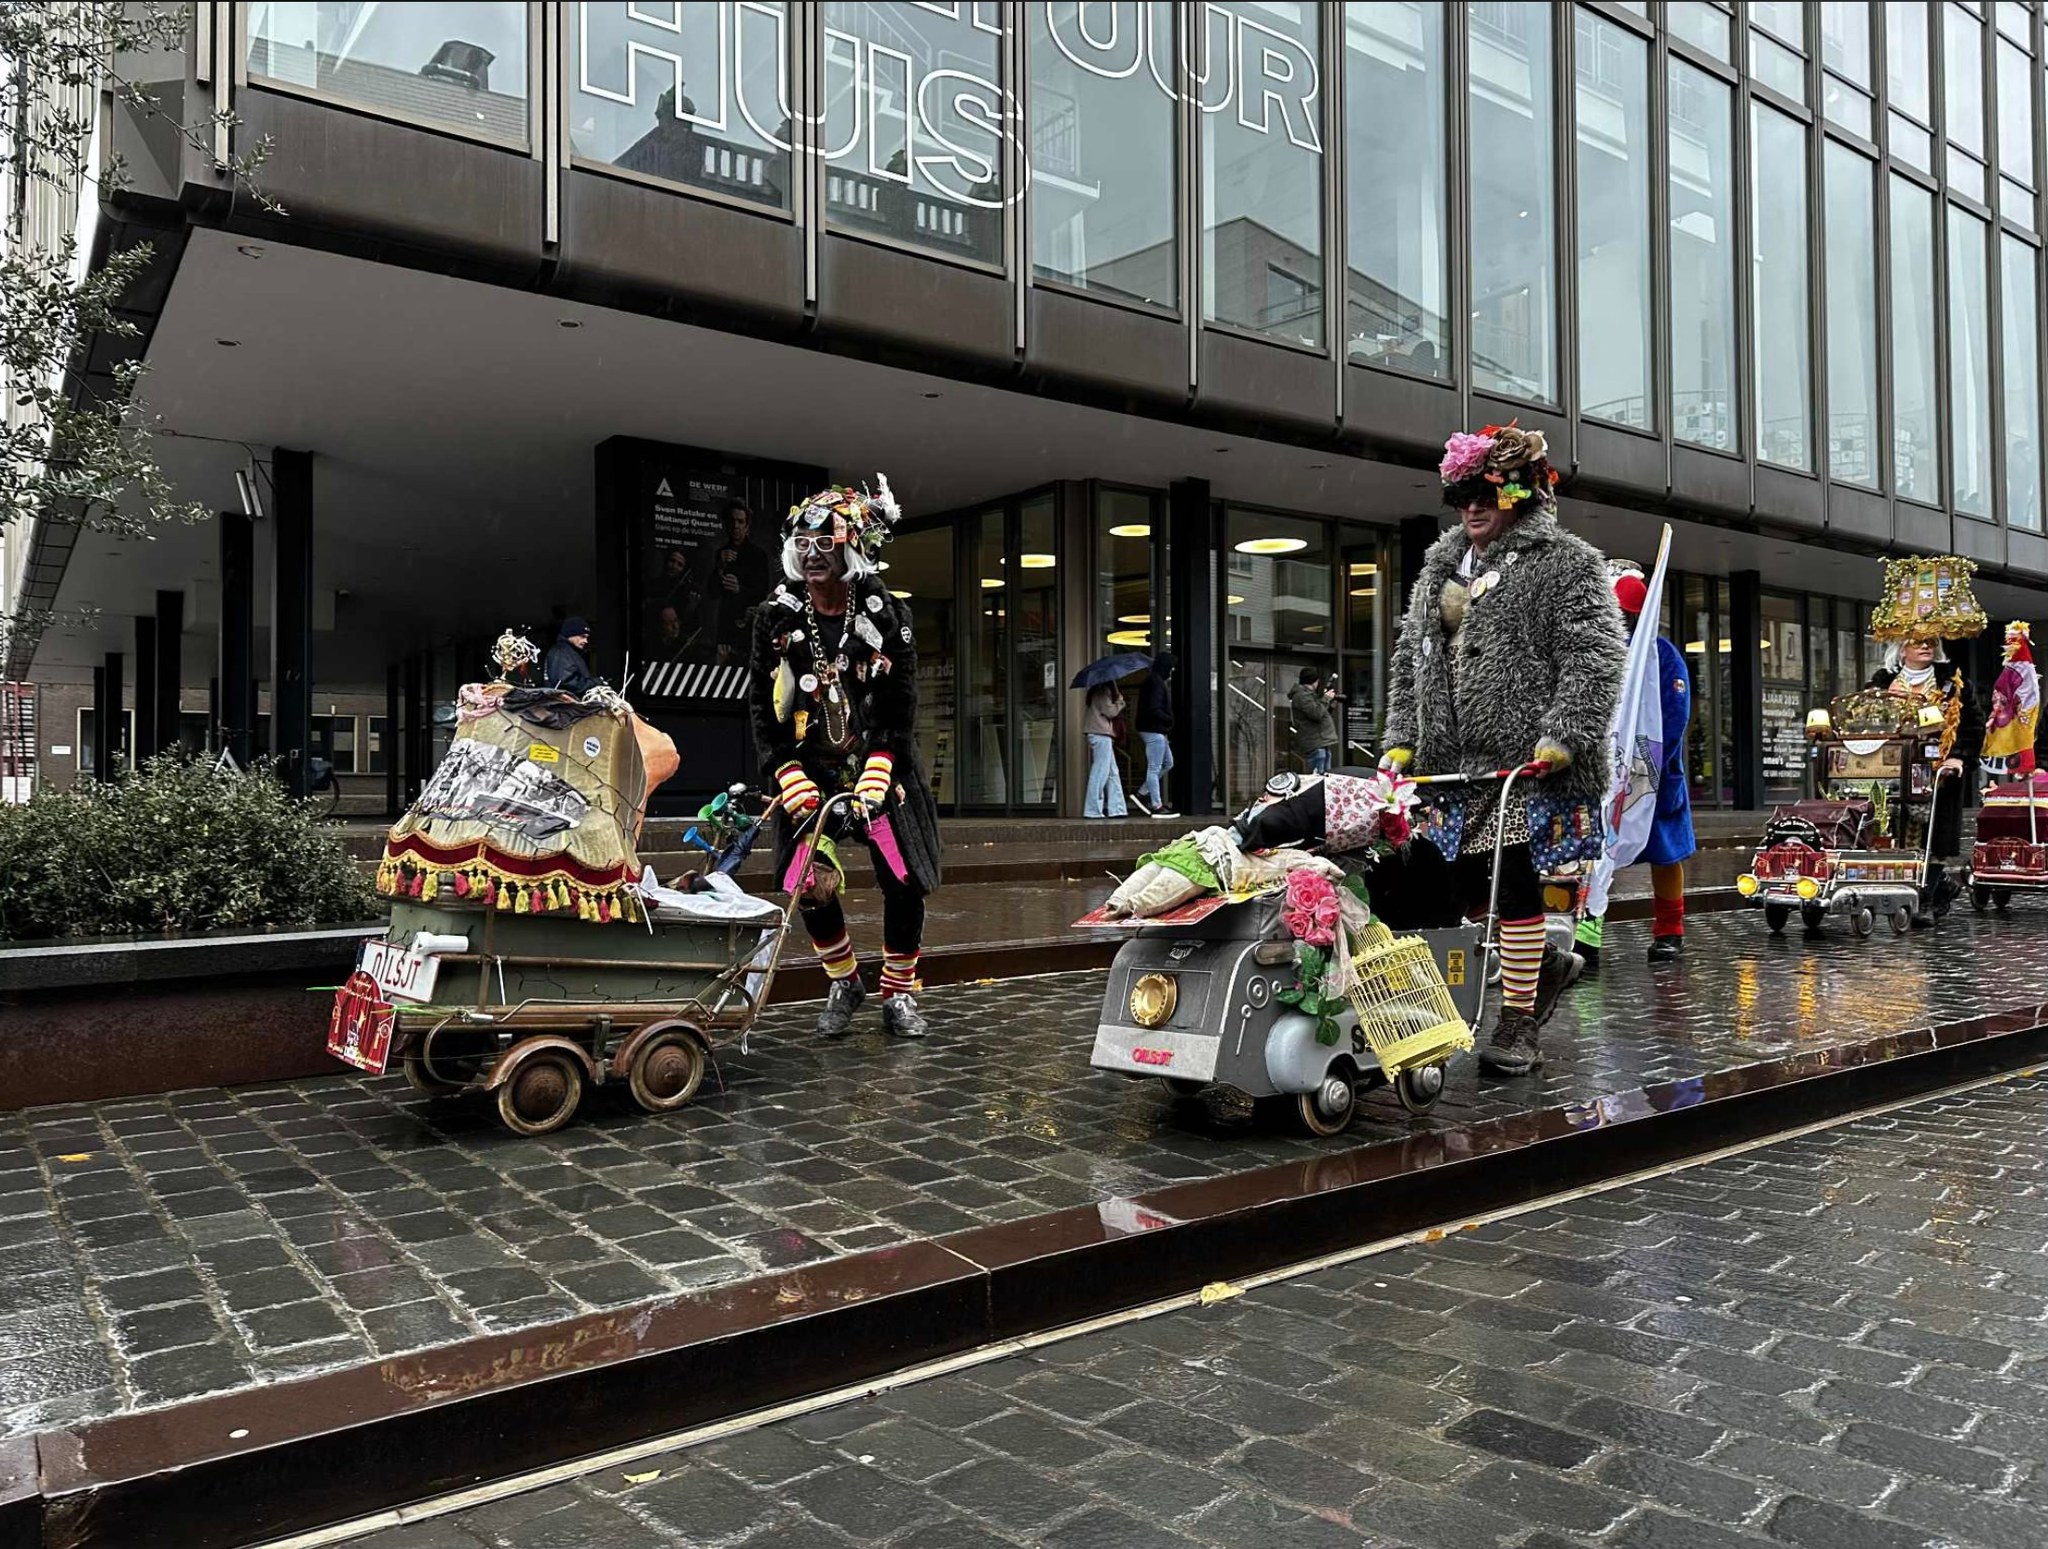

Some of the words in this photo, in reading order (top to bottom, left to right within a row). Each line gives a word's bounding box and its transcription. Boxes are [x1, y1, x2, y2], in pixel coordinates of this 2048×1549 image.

[578, 0, 1031, 208] HUIS
[689, 480, 701, 489] DE
[703, 482, 728, 492] WERF
[654, 504, 676, 514] Sven
[677, 507, 706, 518] Ratzke
[654, 513, 690, 526] Matangi
[690, 518, 723, 529] Quartet
